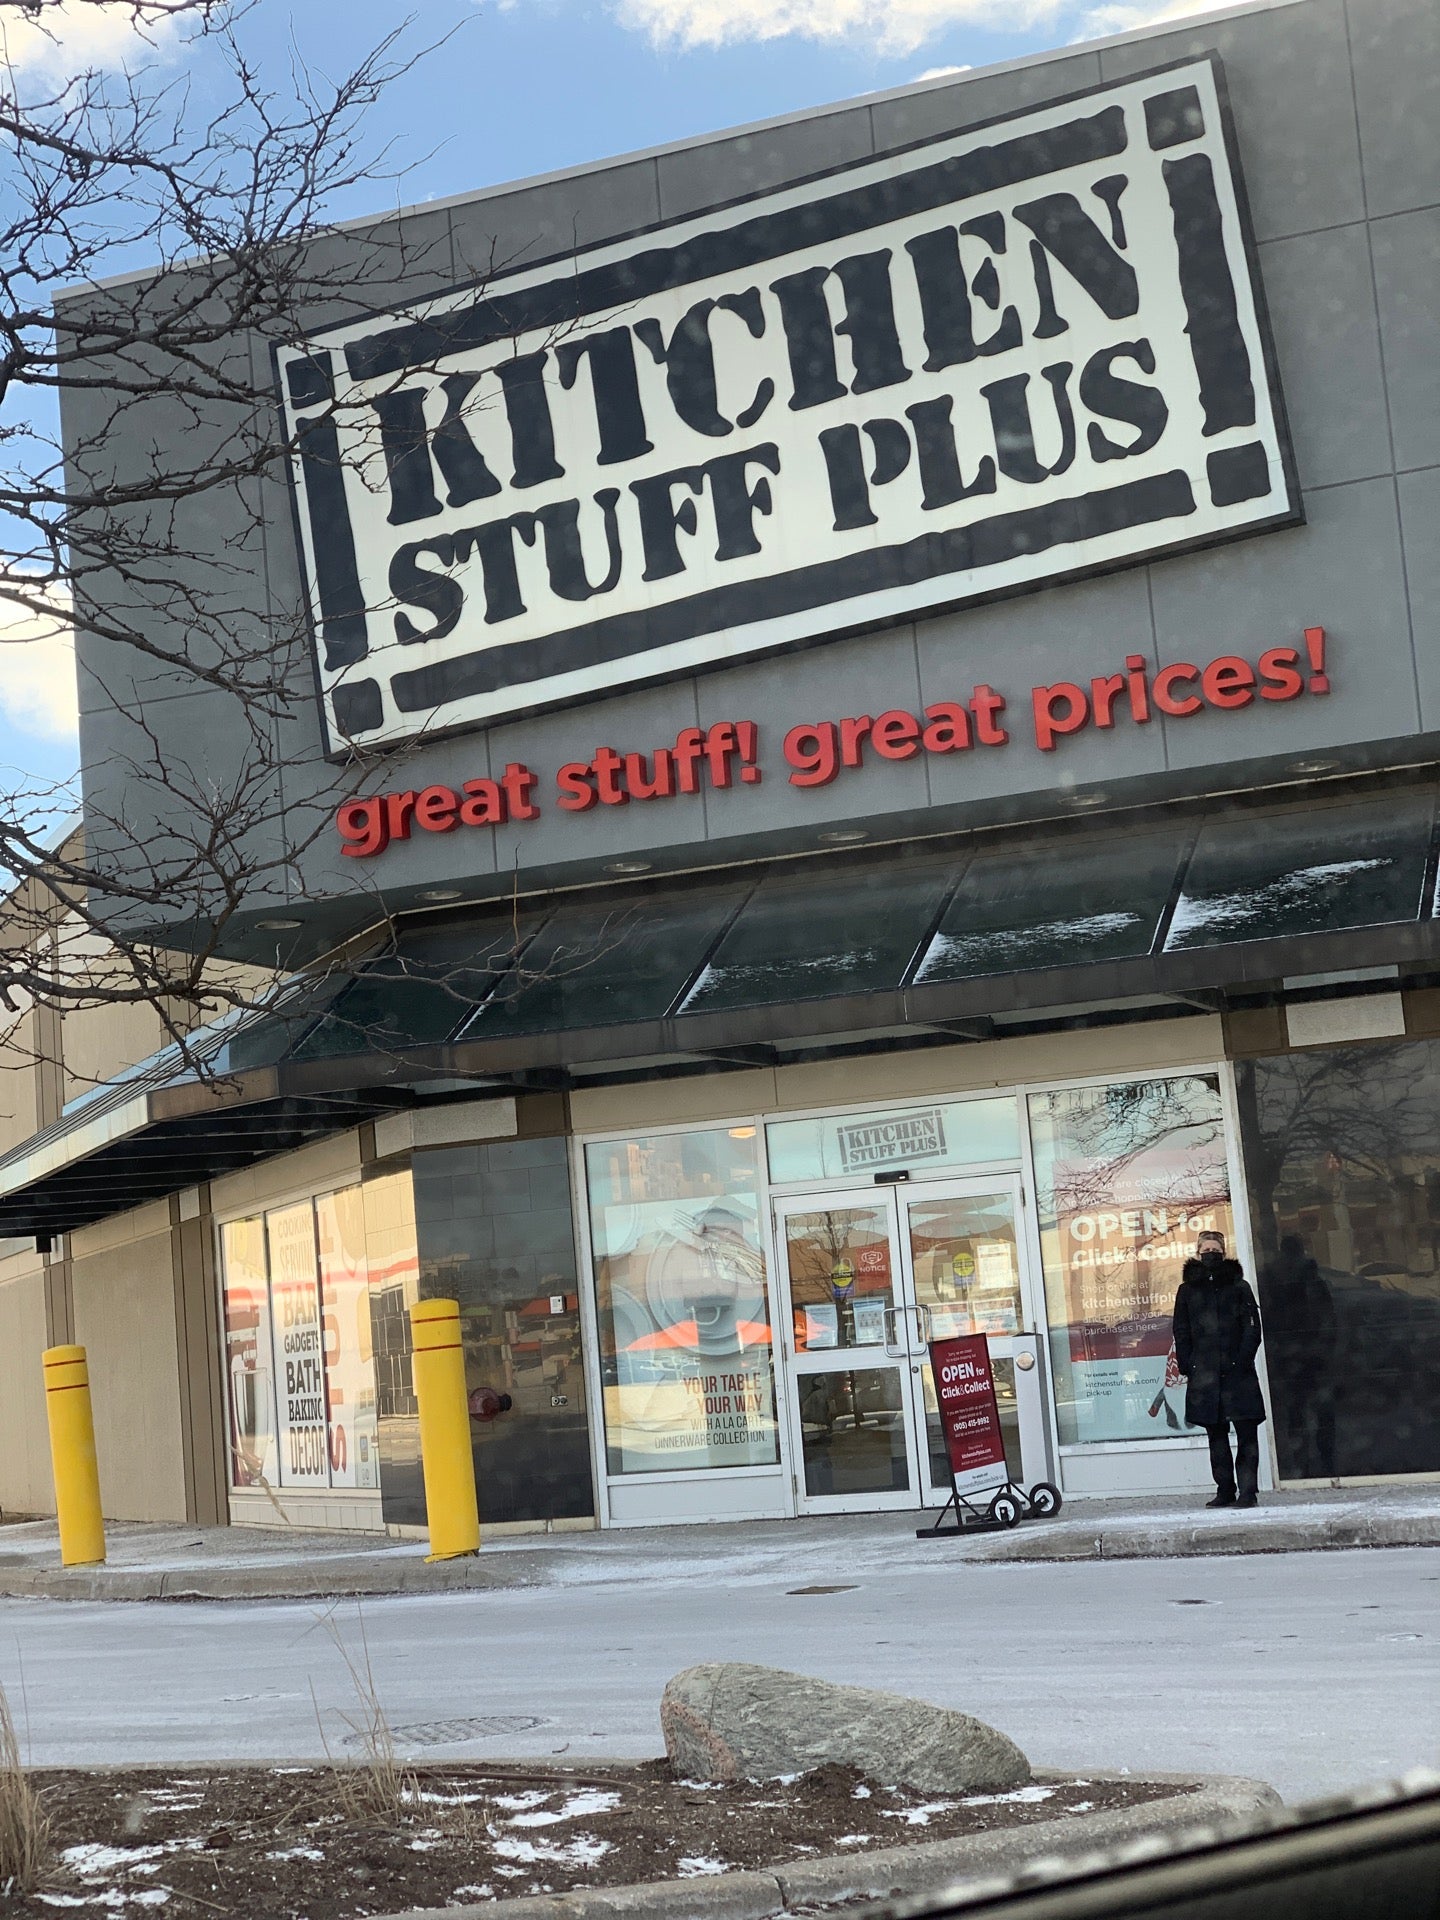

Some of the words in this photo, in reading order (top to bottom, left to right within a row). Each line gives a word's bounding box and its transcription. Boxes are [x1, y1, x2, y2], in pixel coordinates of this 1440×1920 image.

[377, 174, 1140, 526] KITCHEN
[387, 442, 781, 643] STUFF
[818, 340, 1170, 532] PLUS
[336, 763, 535, 858] great
[556, 720, 762, 813] stuff!
[783, 684, 1008, 788] great
[1031, 626, 1333, 752] prices!
[848, 1118, 935, 1149] KITCHEN
[850, 1143, 896, 1163] STUFF
[900, 1136, 937, 1154] PLUS
[1070, 1208, 1168, 1241] OPEN
[1178, 1211, 1215, 1232] for
[860, 1265, 887, 1273] NOTICE
[1139, 1280, 1149, 1289] at
[1082, 1292, 1176, 1309] kitchenstuffpl
[1084, 1323, 1133, 1336] purchases
[1135, 1321, 1160, 1332] here.
[285, 1358, 321, 1395] BATH
[683, 1375, 718, 1395] YOUR
[720, 1372, 762, 1392] TABLE
[941, 1362, 975, 1383] OPEN
[976, 1367, 985, 1376] for
[941, 1379, 991, 1399] Click&Collect
[696, 1396, 731, 1415] YOUR
[734, 1393, 763, 1412] WAY
[691, 1418, 713, 1430] WITH
[715, 1418, 721, 1429] A
[723, 1416, 735, 1429] LA
[736, 1414, 765, 1429] CARTE
[654, 1432, 712, 1449] DINNERWARE
[713, 1430, 768, 1446] COLLECTION.
